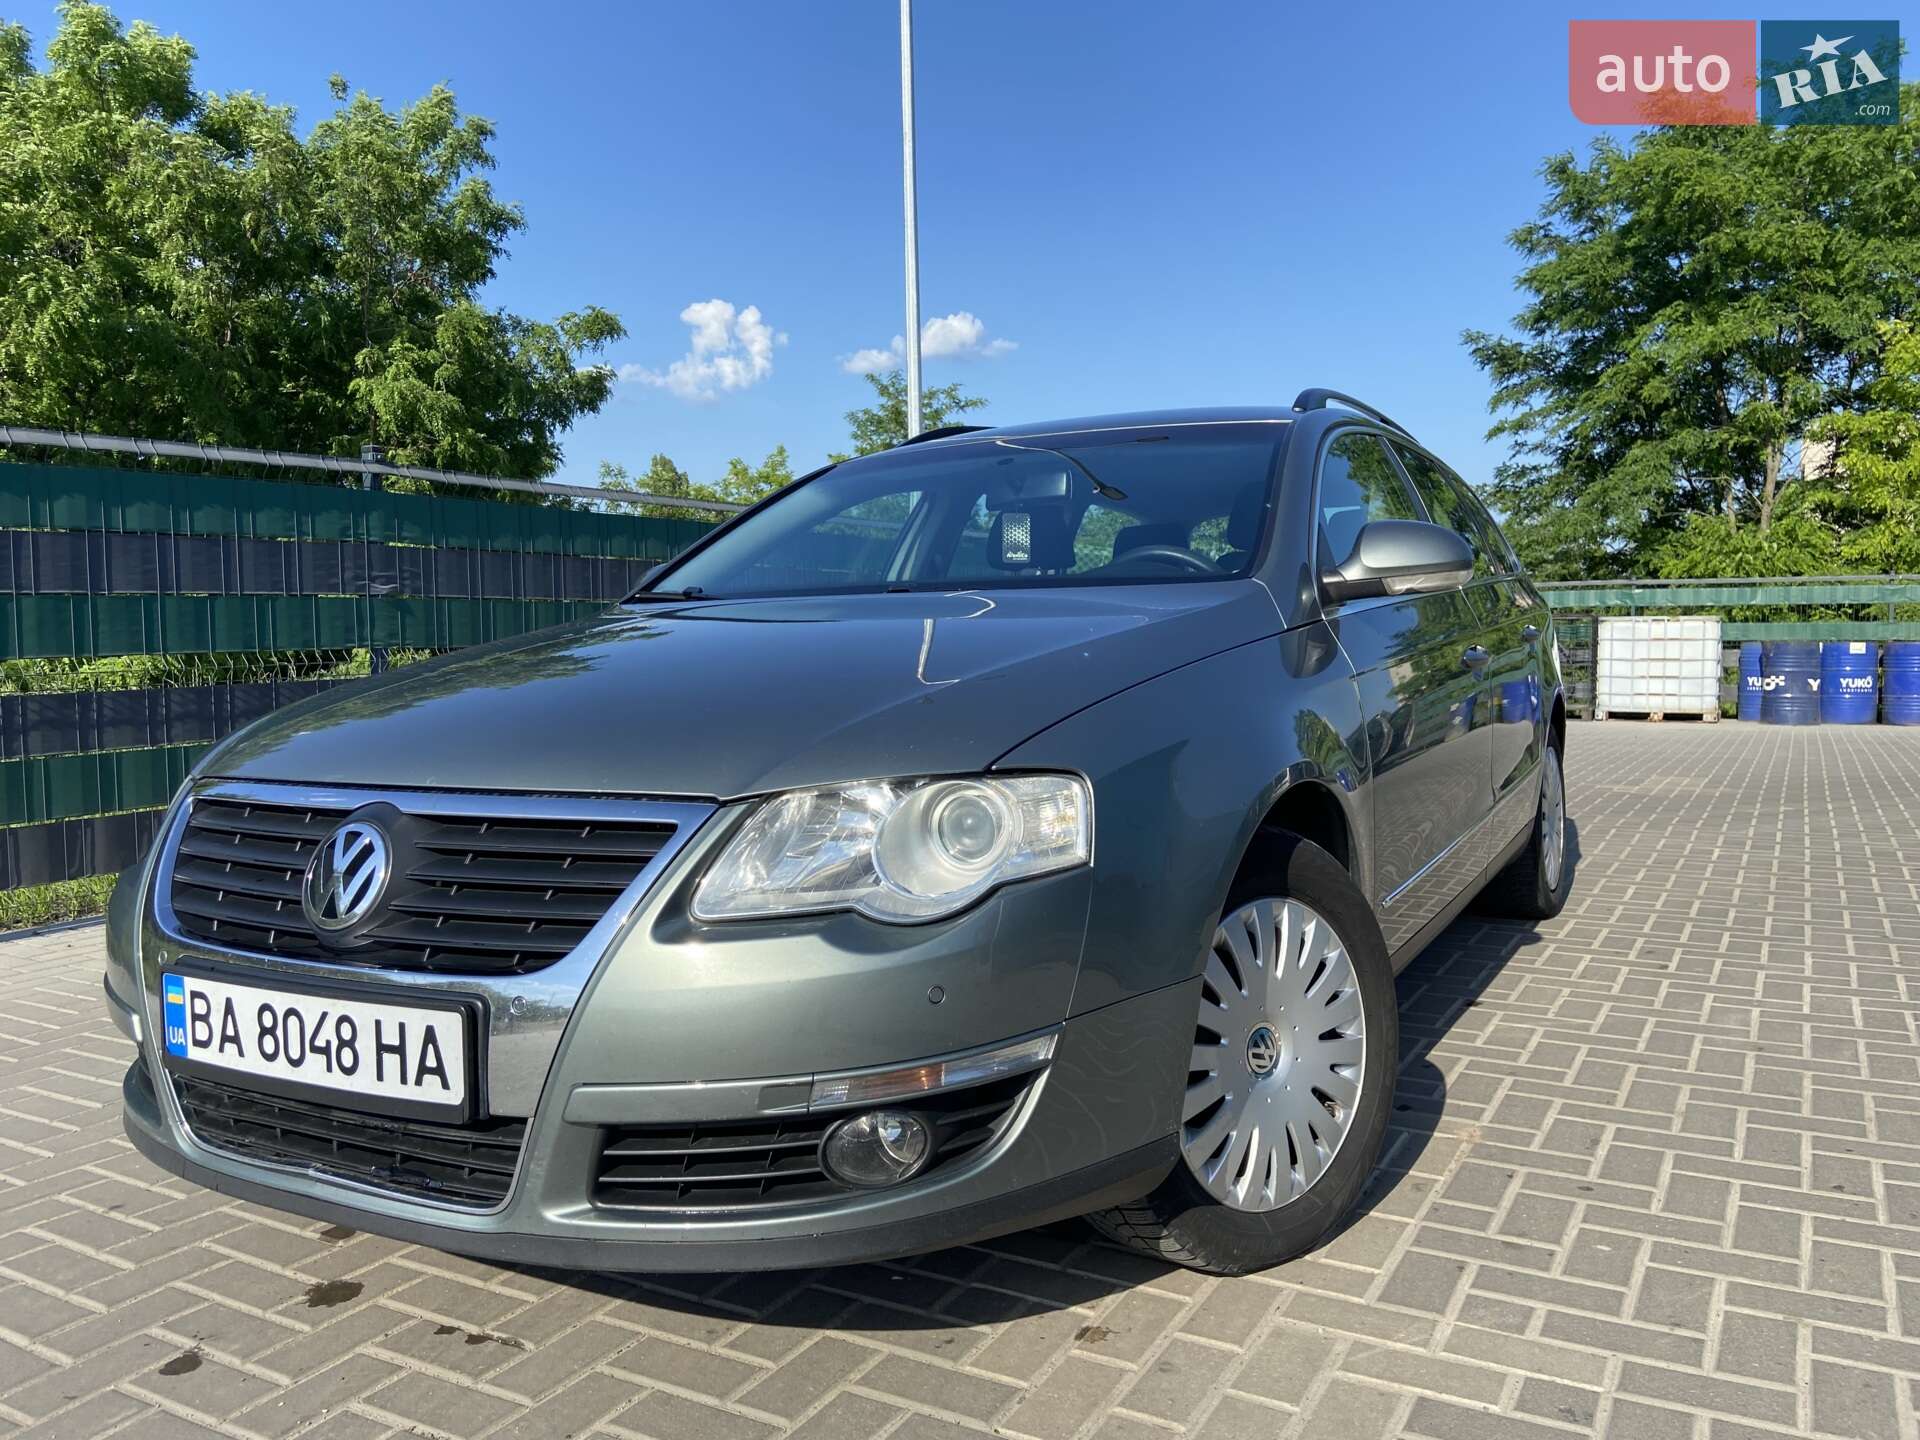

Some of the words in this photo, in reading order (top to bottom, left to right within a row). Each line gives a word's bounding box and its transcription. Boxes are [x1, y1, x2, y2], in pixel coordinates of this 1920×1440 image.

[170, 1026, 186, 1046] UA
[190, 990, 245, 1058] BA
[257, 1003, 360, 1076] 8048
[375, 1018, 450, 1091] HA
